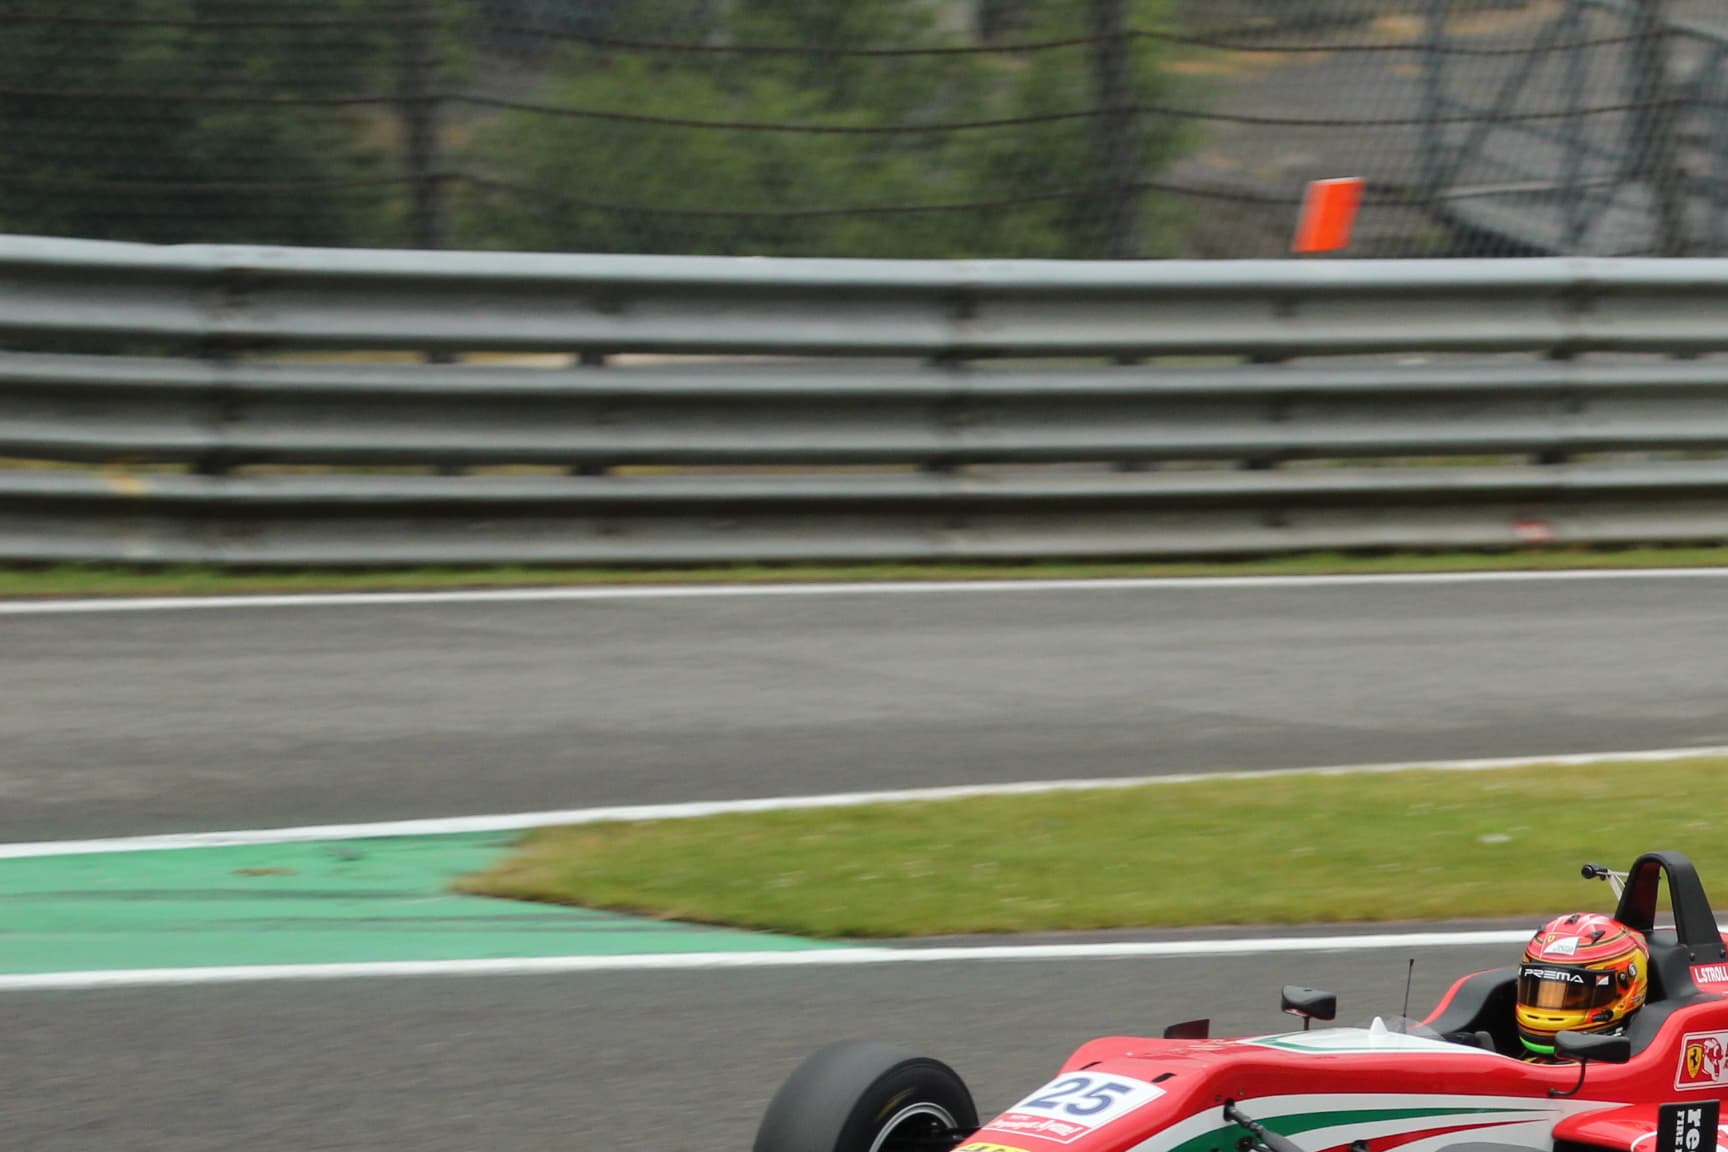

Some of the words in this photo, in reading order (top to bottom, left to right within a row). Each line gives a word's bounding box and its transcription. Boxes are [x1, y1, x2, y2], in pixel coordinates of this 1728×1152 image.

[1524, 968, 1584, 984] PREMA
[1020, 1077, 1135, 1117] 25
[1674, 1110, 1686, 1146] FIRE
